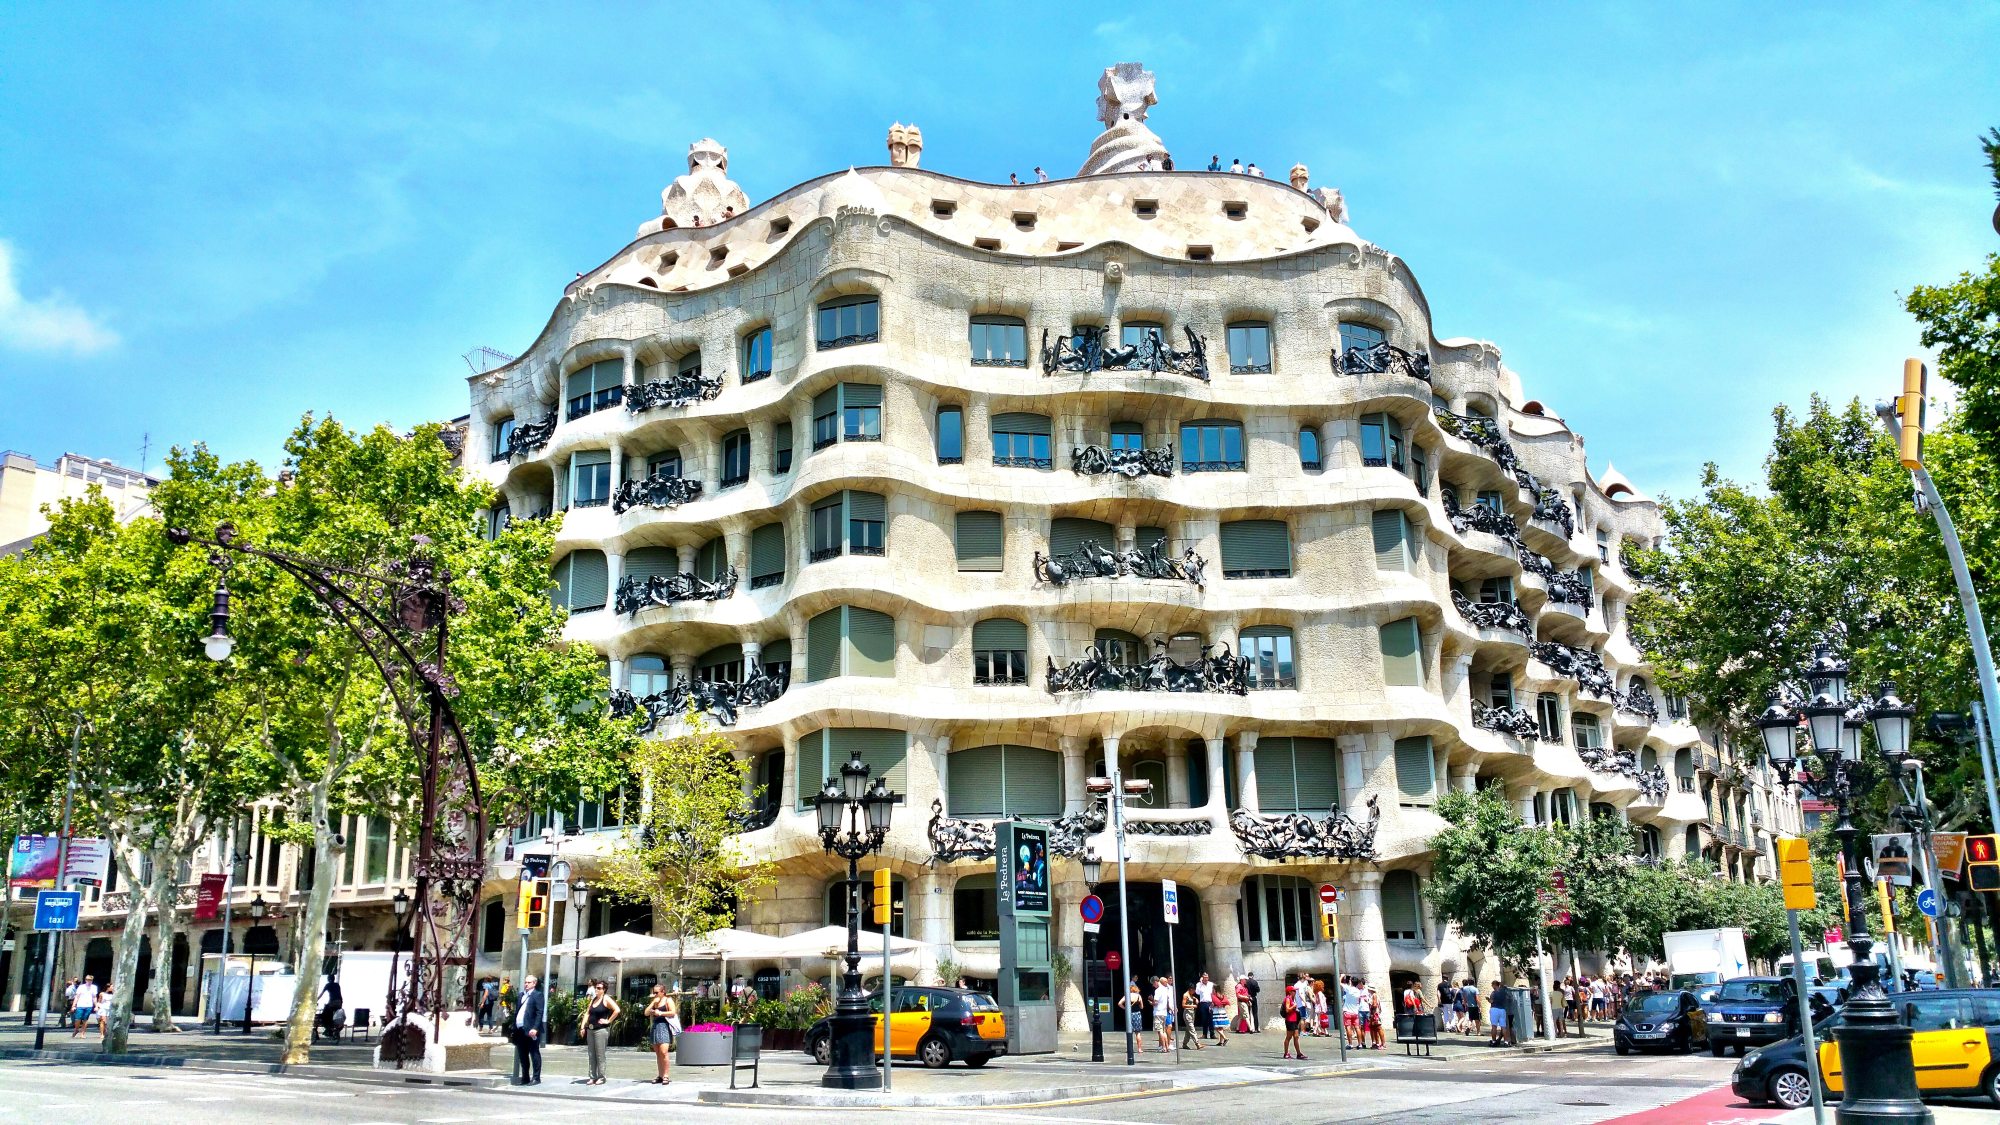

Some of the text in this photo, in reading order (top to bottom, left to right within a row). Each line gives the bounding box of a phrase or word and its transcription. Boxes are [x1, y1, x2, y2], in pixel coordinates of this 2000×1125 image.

[1000, 846, 1011, 902] La Pedrera
[49, 916, 65, 924] taxi
